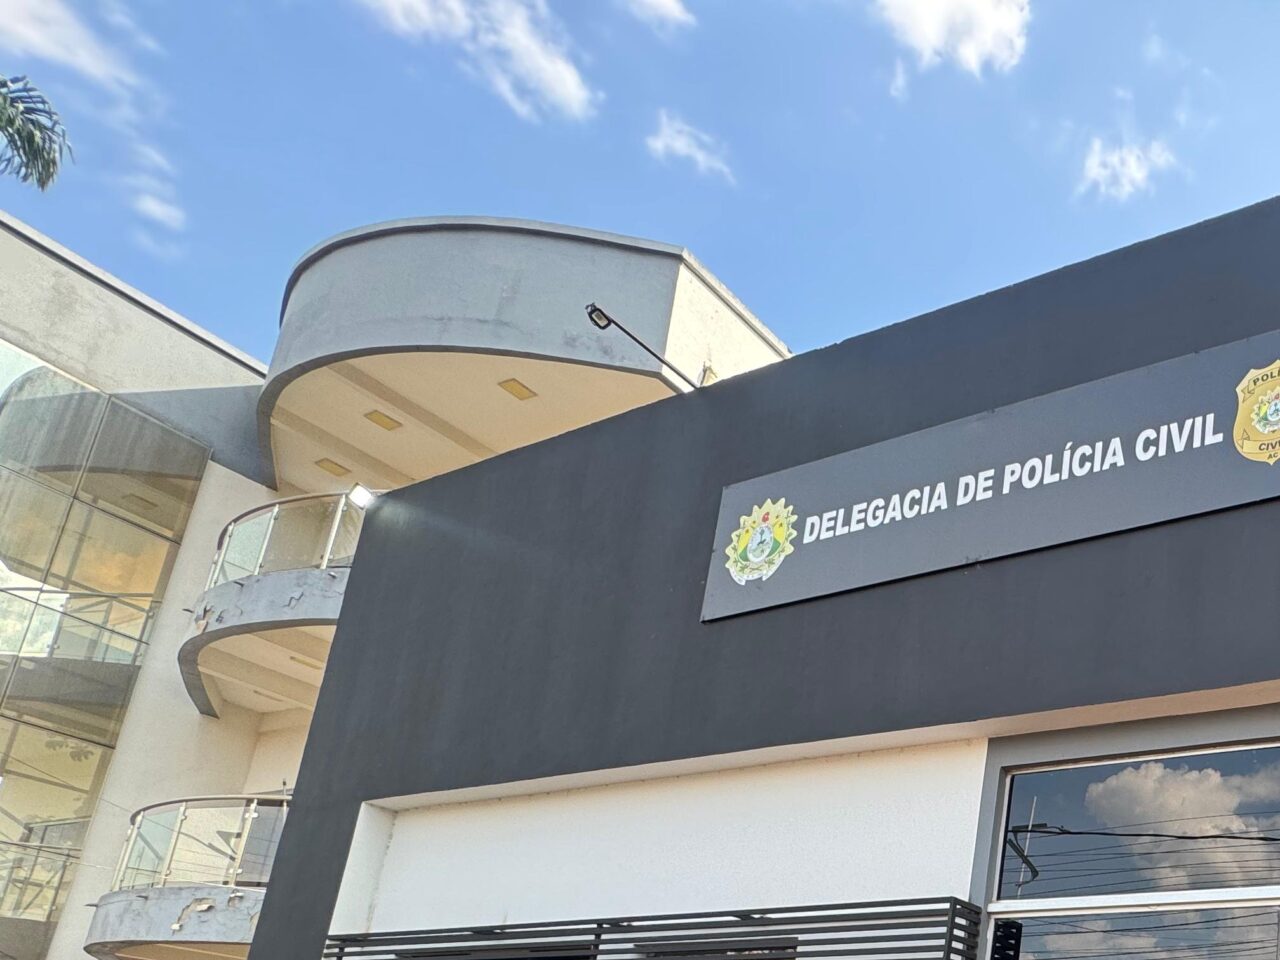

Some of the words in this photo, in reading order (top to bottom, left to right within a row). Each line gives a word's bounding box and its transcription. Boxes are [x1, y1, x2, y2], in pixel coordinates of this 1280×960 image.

[802, 481, 948, 544] DELEGACIA
[956, 468, 995, 506] DE
[1002, 437, 1125, 495] POLÍCIA
[1135, 412, 1224, 462] CIVIL
[1267, 452, 1279, 460] AC
